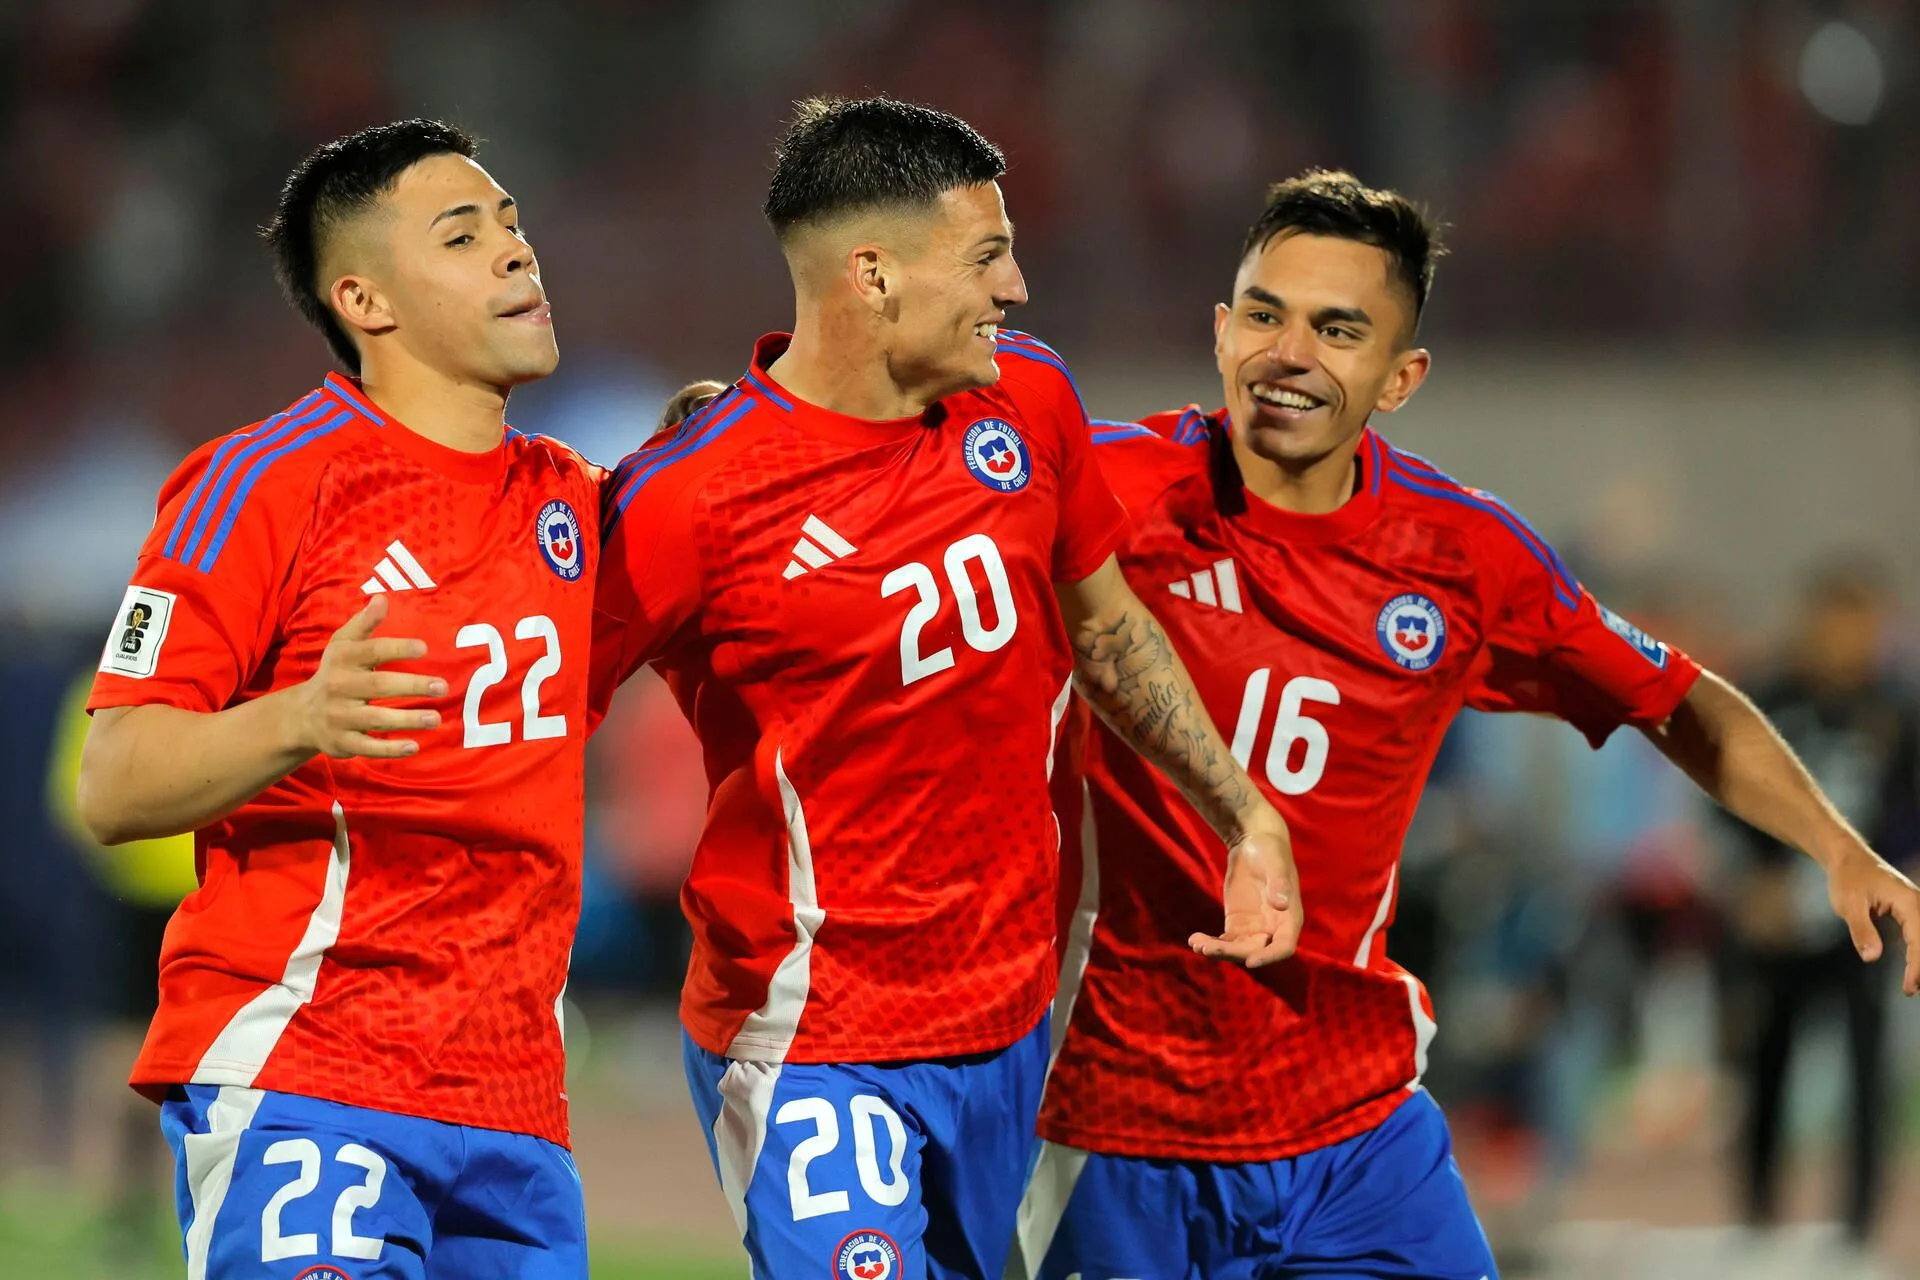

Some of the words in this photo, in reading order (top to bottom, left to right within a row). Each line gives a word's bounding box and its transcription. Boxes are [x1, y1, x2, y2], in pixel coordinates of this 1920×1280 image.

[965, 425, 982, 470] FEDERACION
[984, 421, 994, 430] DE
[998, 422, 1022, 448] FUTBOL
[1001, 481, 1012, 490] DE
[1013, 470, 1028, 488] CHILE
[559, 502, 566, 513] DE
[558, 567, 567, 577] DE
[568, 563, 580, 578] CHILE
[881, 533, 1018, 687] 20
[455, 615, 567, 749] 22
[1230, 667, 1341, 795] 16
[262, 1138, 387, 1263] 22
[776, 1094, 910, 1222] 20
[839, 1236, 865, 1271] FEDERACION
[868, 1235, 878, 1243] DE
[879, 1240, 897, 1262] FUTBOL
